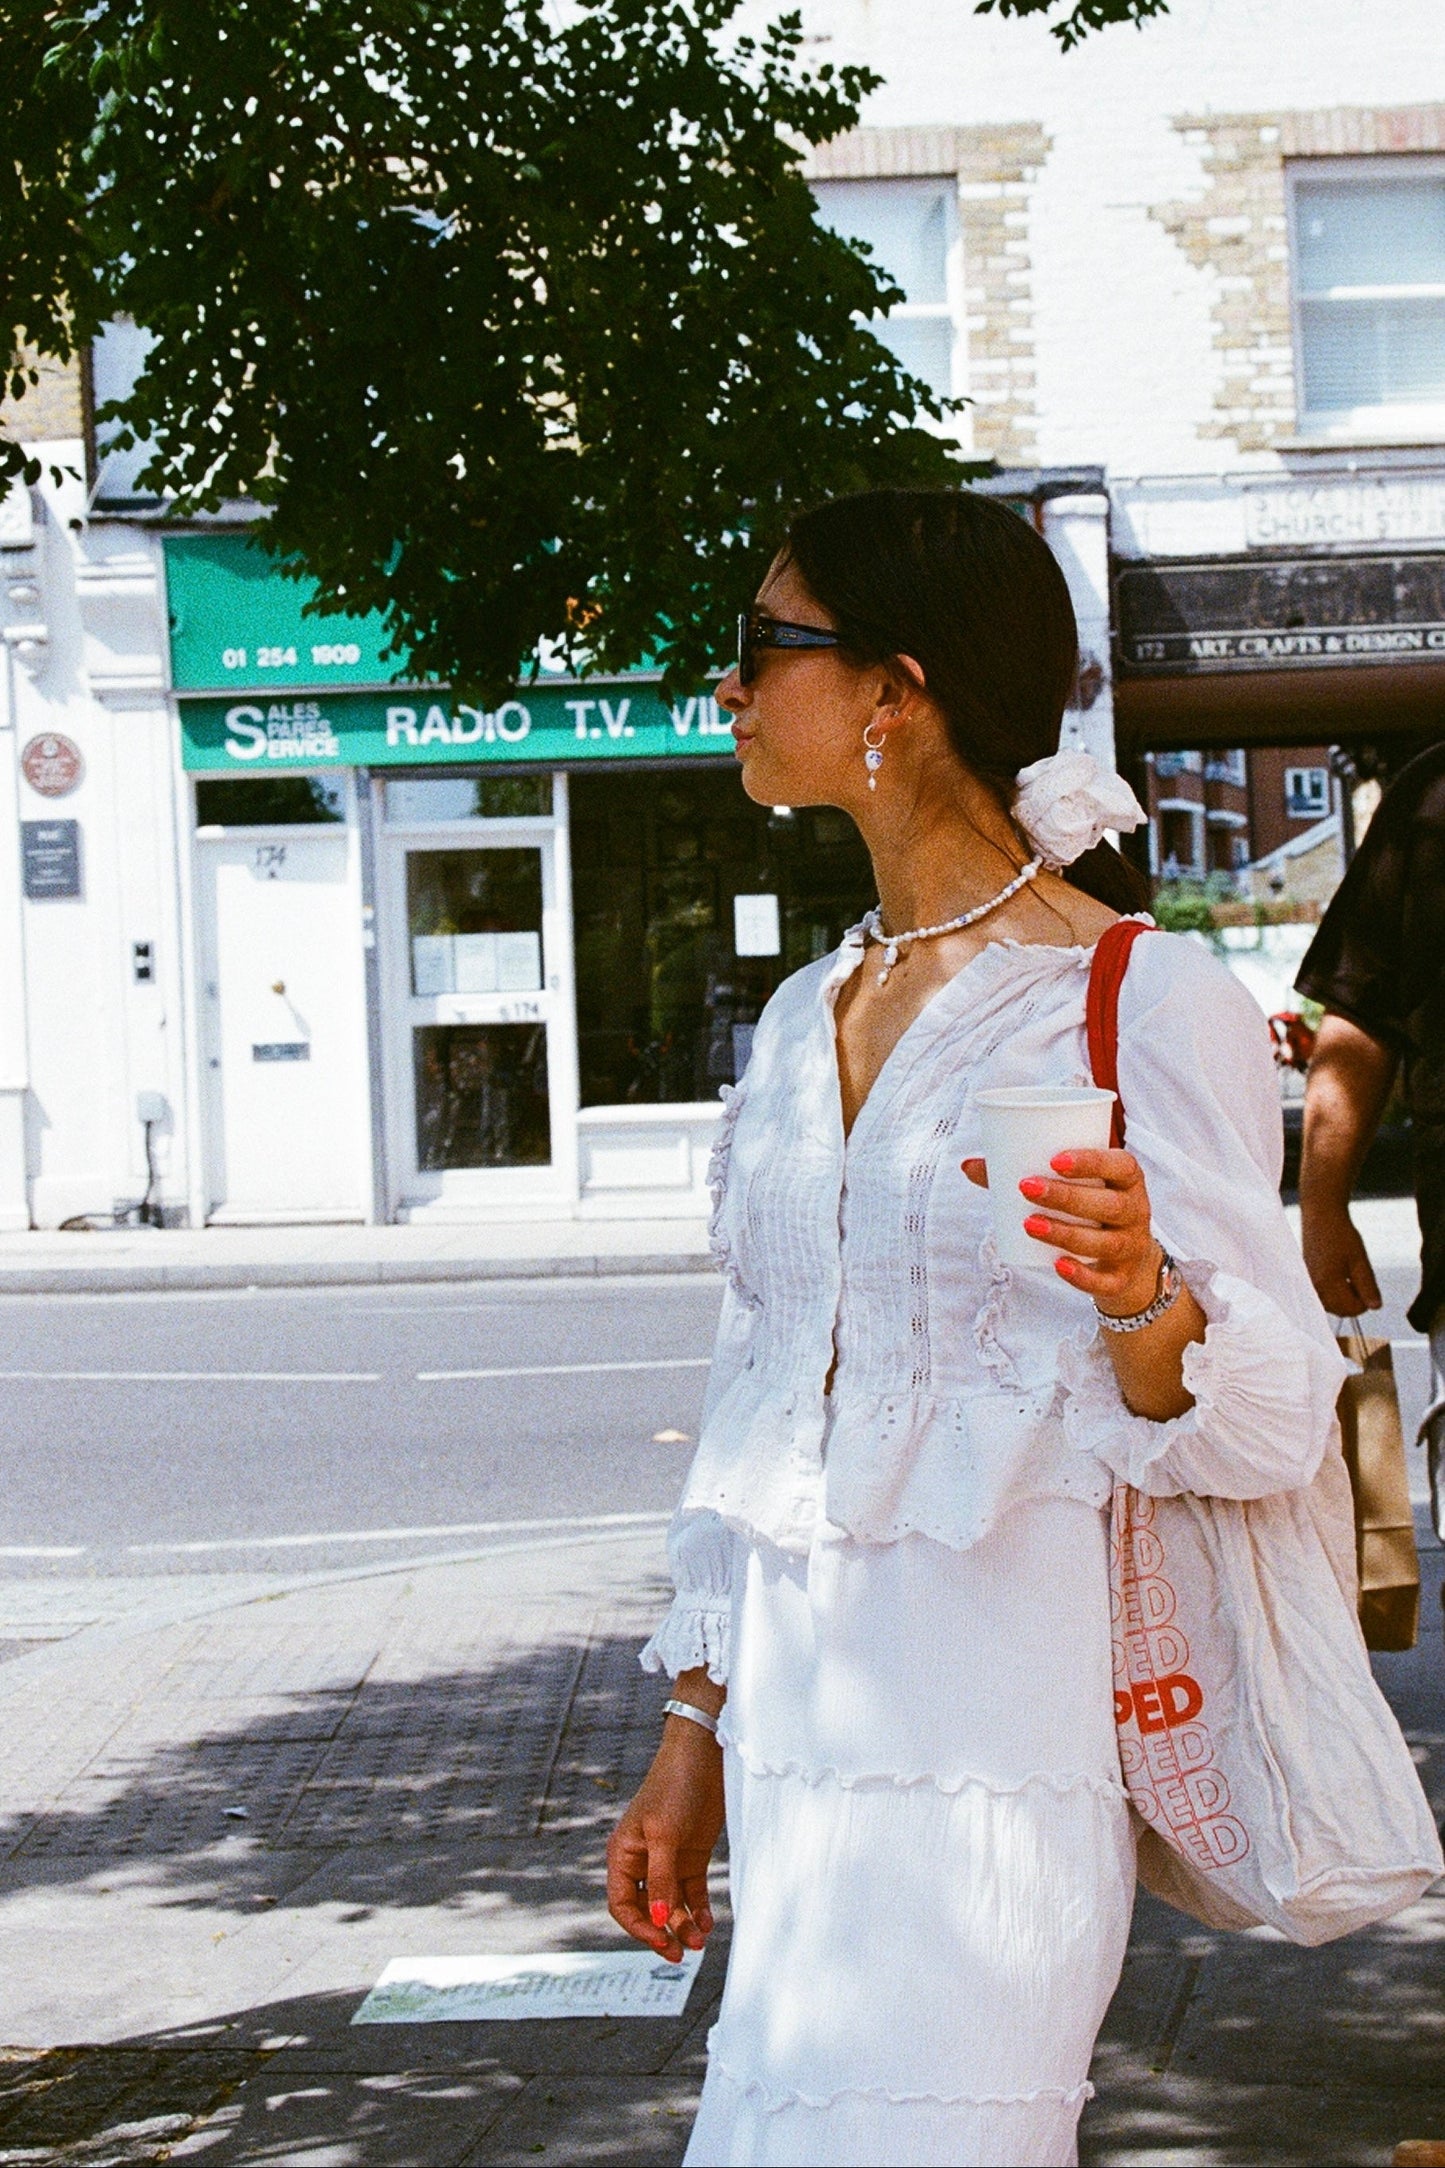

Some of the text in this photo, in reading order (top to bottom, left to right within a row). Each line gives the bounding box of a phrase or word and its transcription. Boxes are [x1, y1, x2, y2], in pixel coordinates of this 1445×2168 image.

[1256, 513, 1364, 538] CHURCH
[1238, 635, 1322, 656] CRAFTS
[1325, 635, 1343, 653] &
[1345, 631, 1424, 652] DESIGN
[222, 648, 247, 669] 01
[256, 646, 297, 667] 254
[386, 701, 531, 746] RADIO
[565, 698, 636, 739] T.V.
